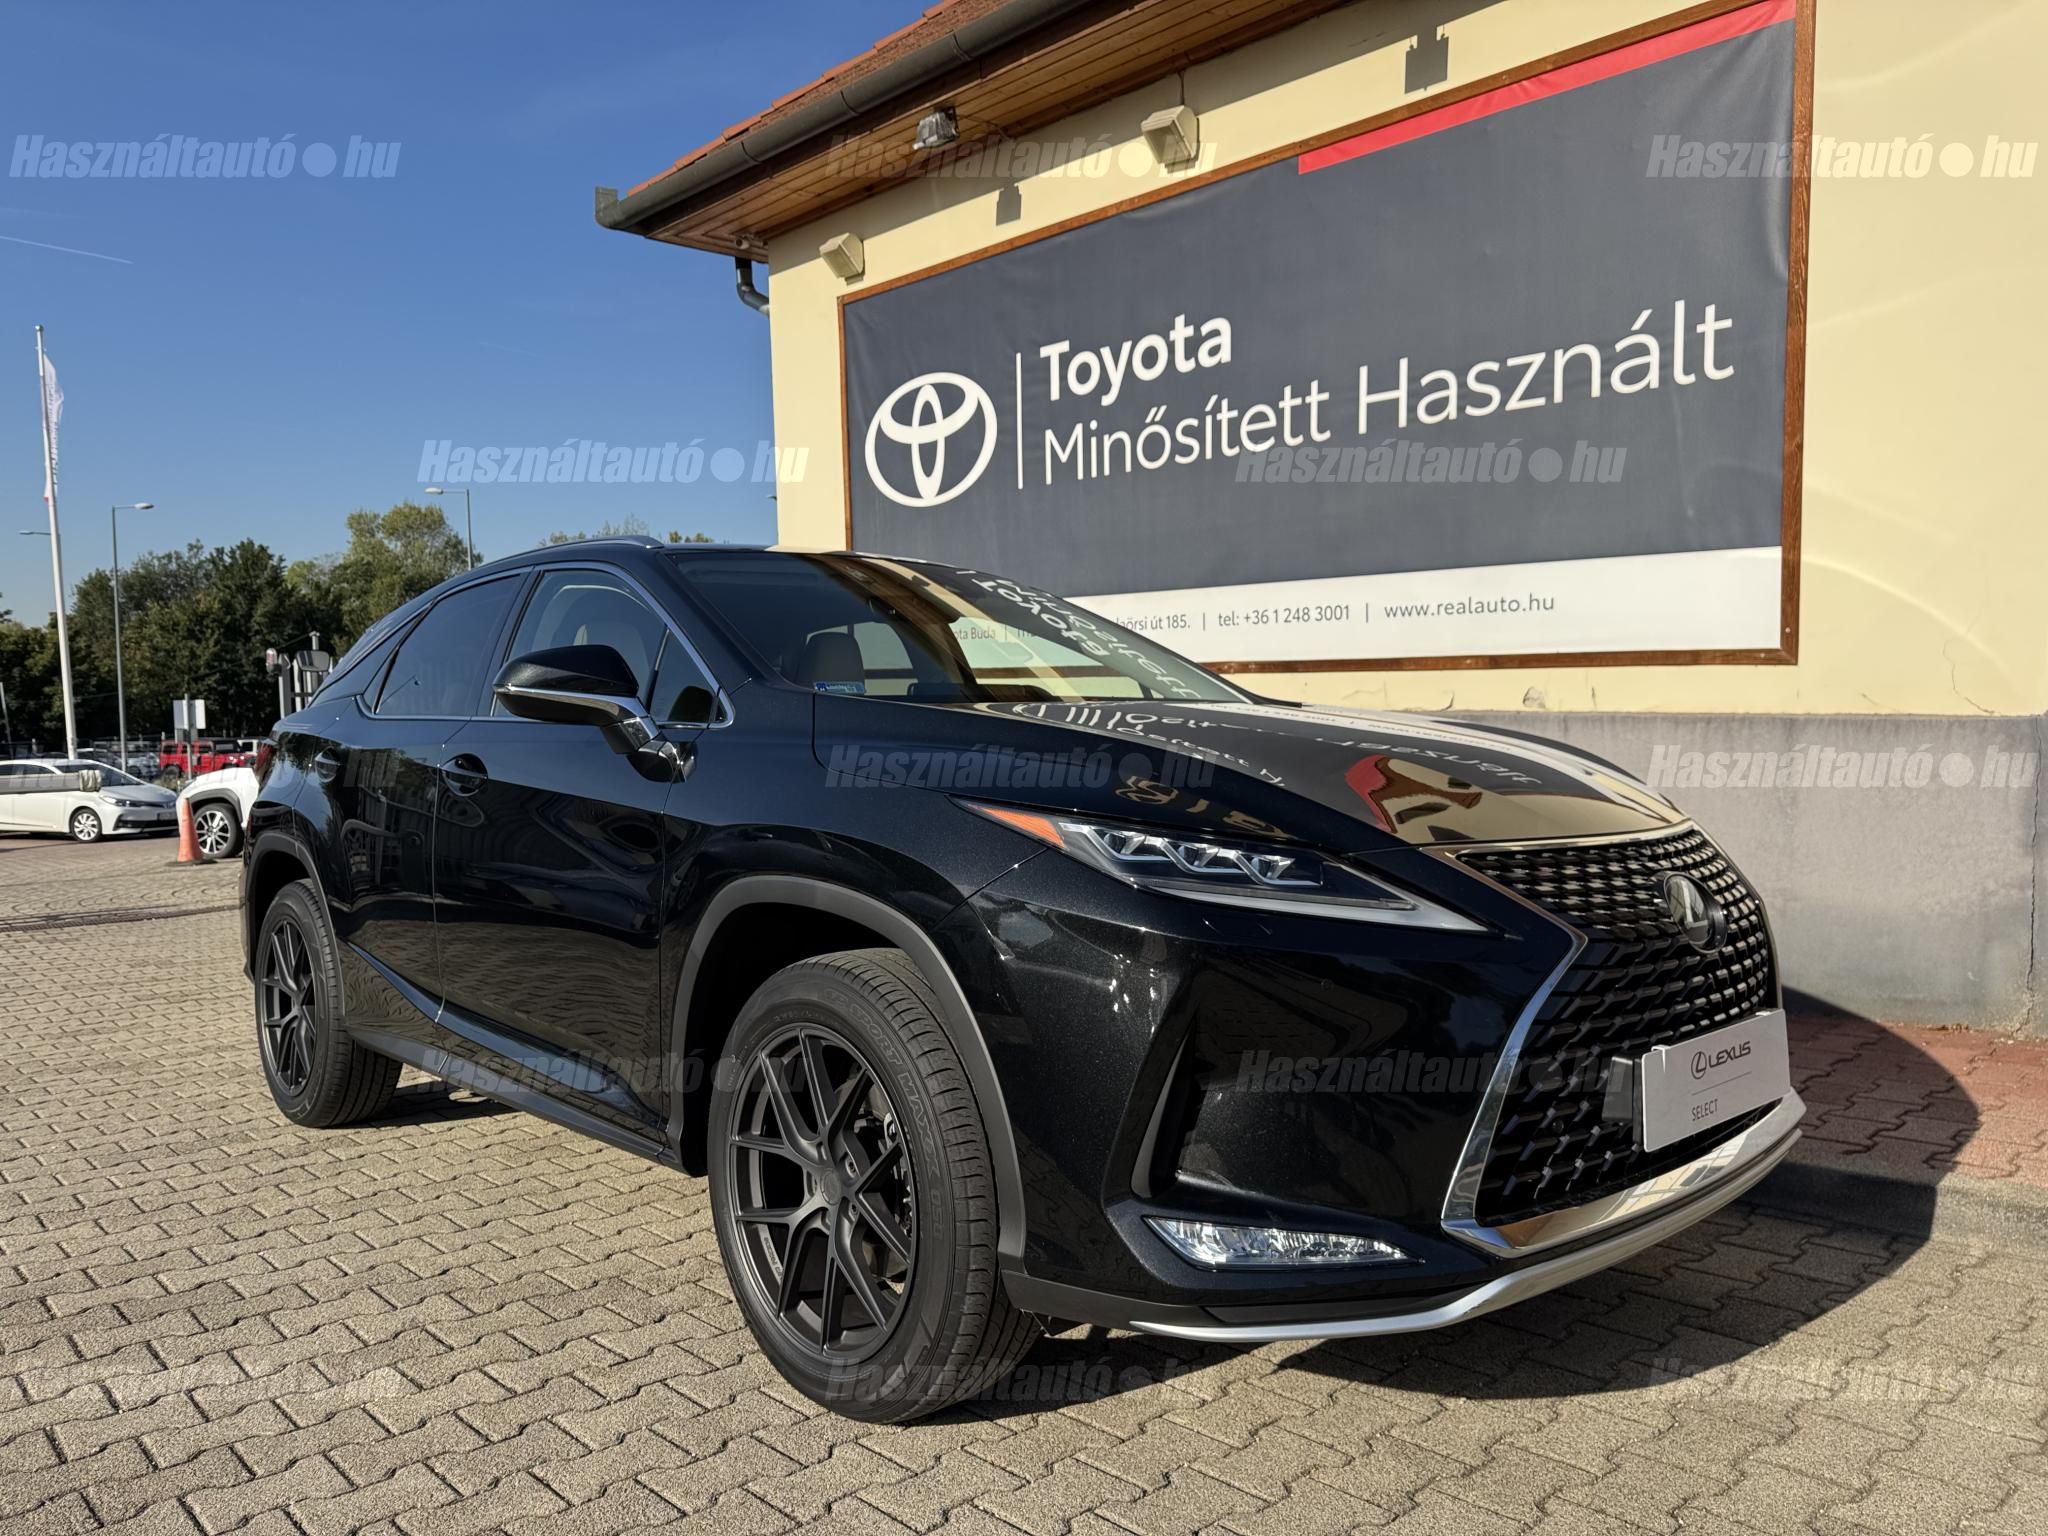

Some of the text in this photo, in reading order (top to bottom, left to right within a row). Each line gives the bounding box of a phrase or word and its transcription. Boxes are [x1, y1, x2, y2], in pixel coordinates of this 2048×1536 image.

[1039, 313, 1232, 407] Toyota
[1044, 299, 1735, 485] Minősített Használt
[1218, 604, 1350, 627] tel: +36 1 248 3001
[1383, 591, 1555, 619] www.realauto.hu
[1150, 613, 1164, 631] út
[1166, 613, 1191, 630] 185.
[1708, 1040, 1752, 1069] LEXUS
[1691, 1098, 1719, 1122] SELECT
[897, 1071, 941, 1179] MAXX
